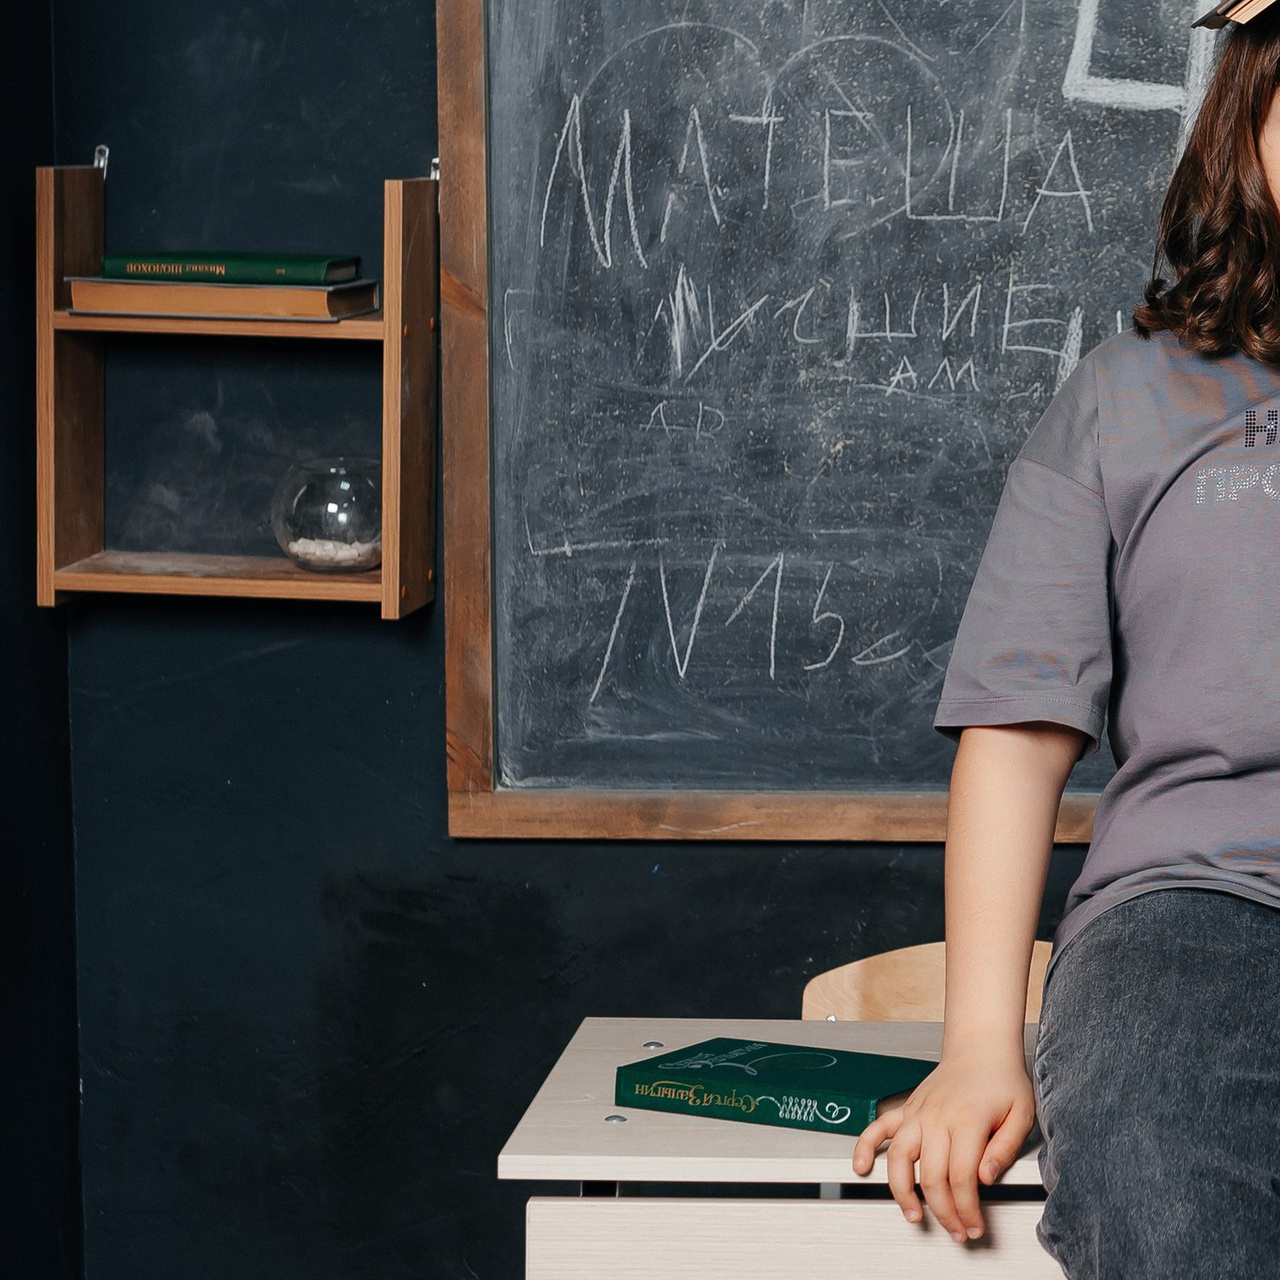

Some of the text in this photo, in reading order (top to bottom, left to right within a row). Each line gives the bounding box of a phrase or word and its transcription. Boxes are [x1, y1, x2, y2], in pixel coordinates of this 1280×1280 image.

[126, 263, 183, 275] ШОЛОХОВ
[634, 1080, 756, 1114] Сергей Залыгин
